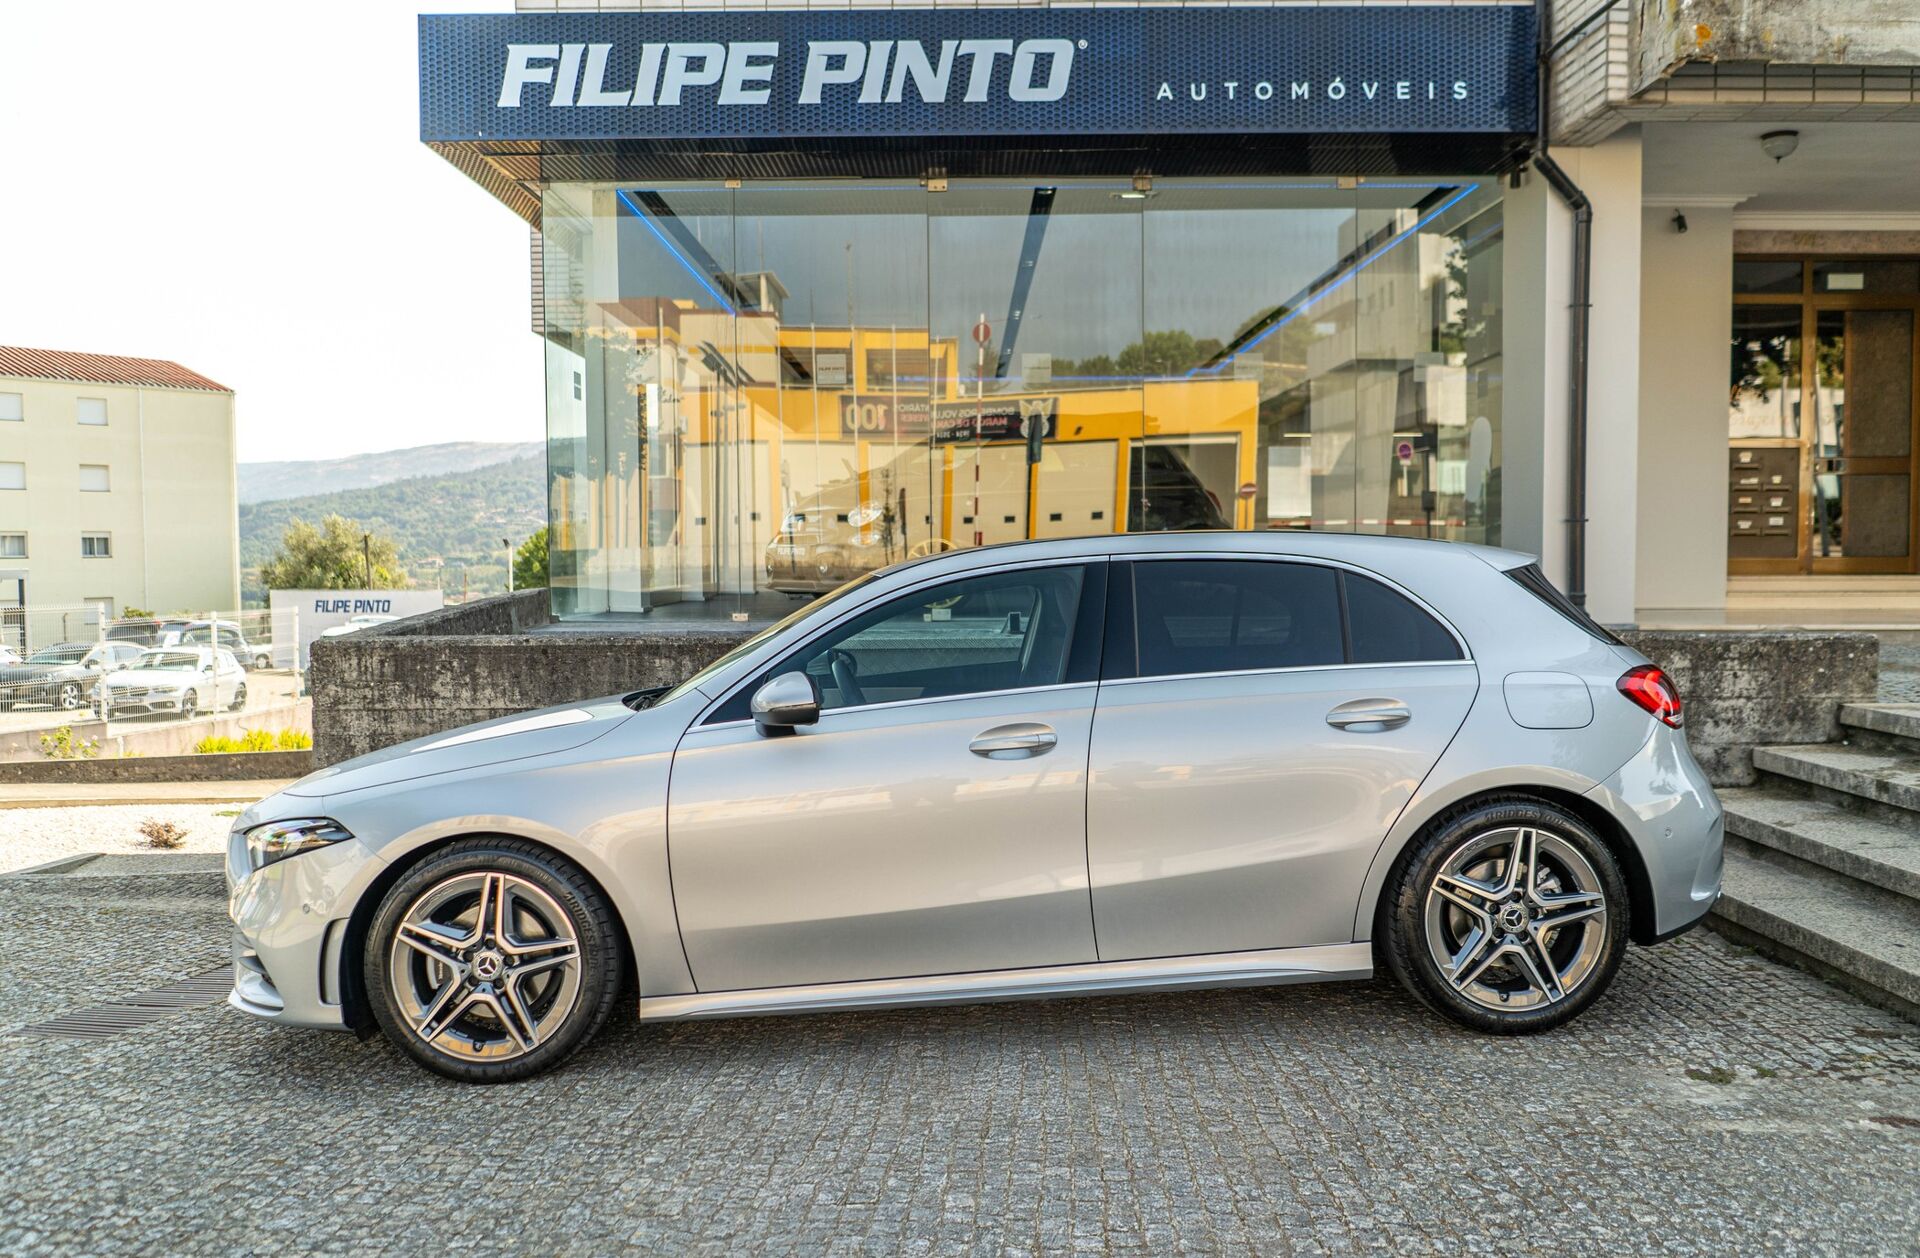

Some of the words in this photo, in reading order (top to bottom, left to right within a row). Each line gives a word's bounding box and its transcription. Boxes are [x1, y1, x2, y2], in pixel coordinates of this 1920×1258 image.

[497, 42, 780, 107] FILIPE
[798, 38, 1075, 104] PINTO
[1156, 77, 1469, 101] AUTOMÓVEIS
[314, 599, 352, 613] FILIPE
[353, 599, 392, 613] PINTO
